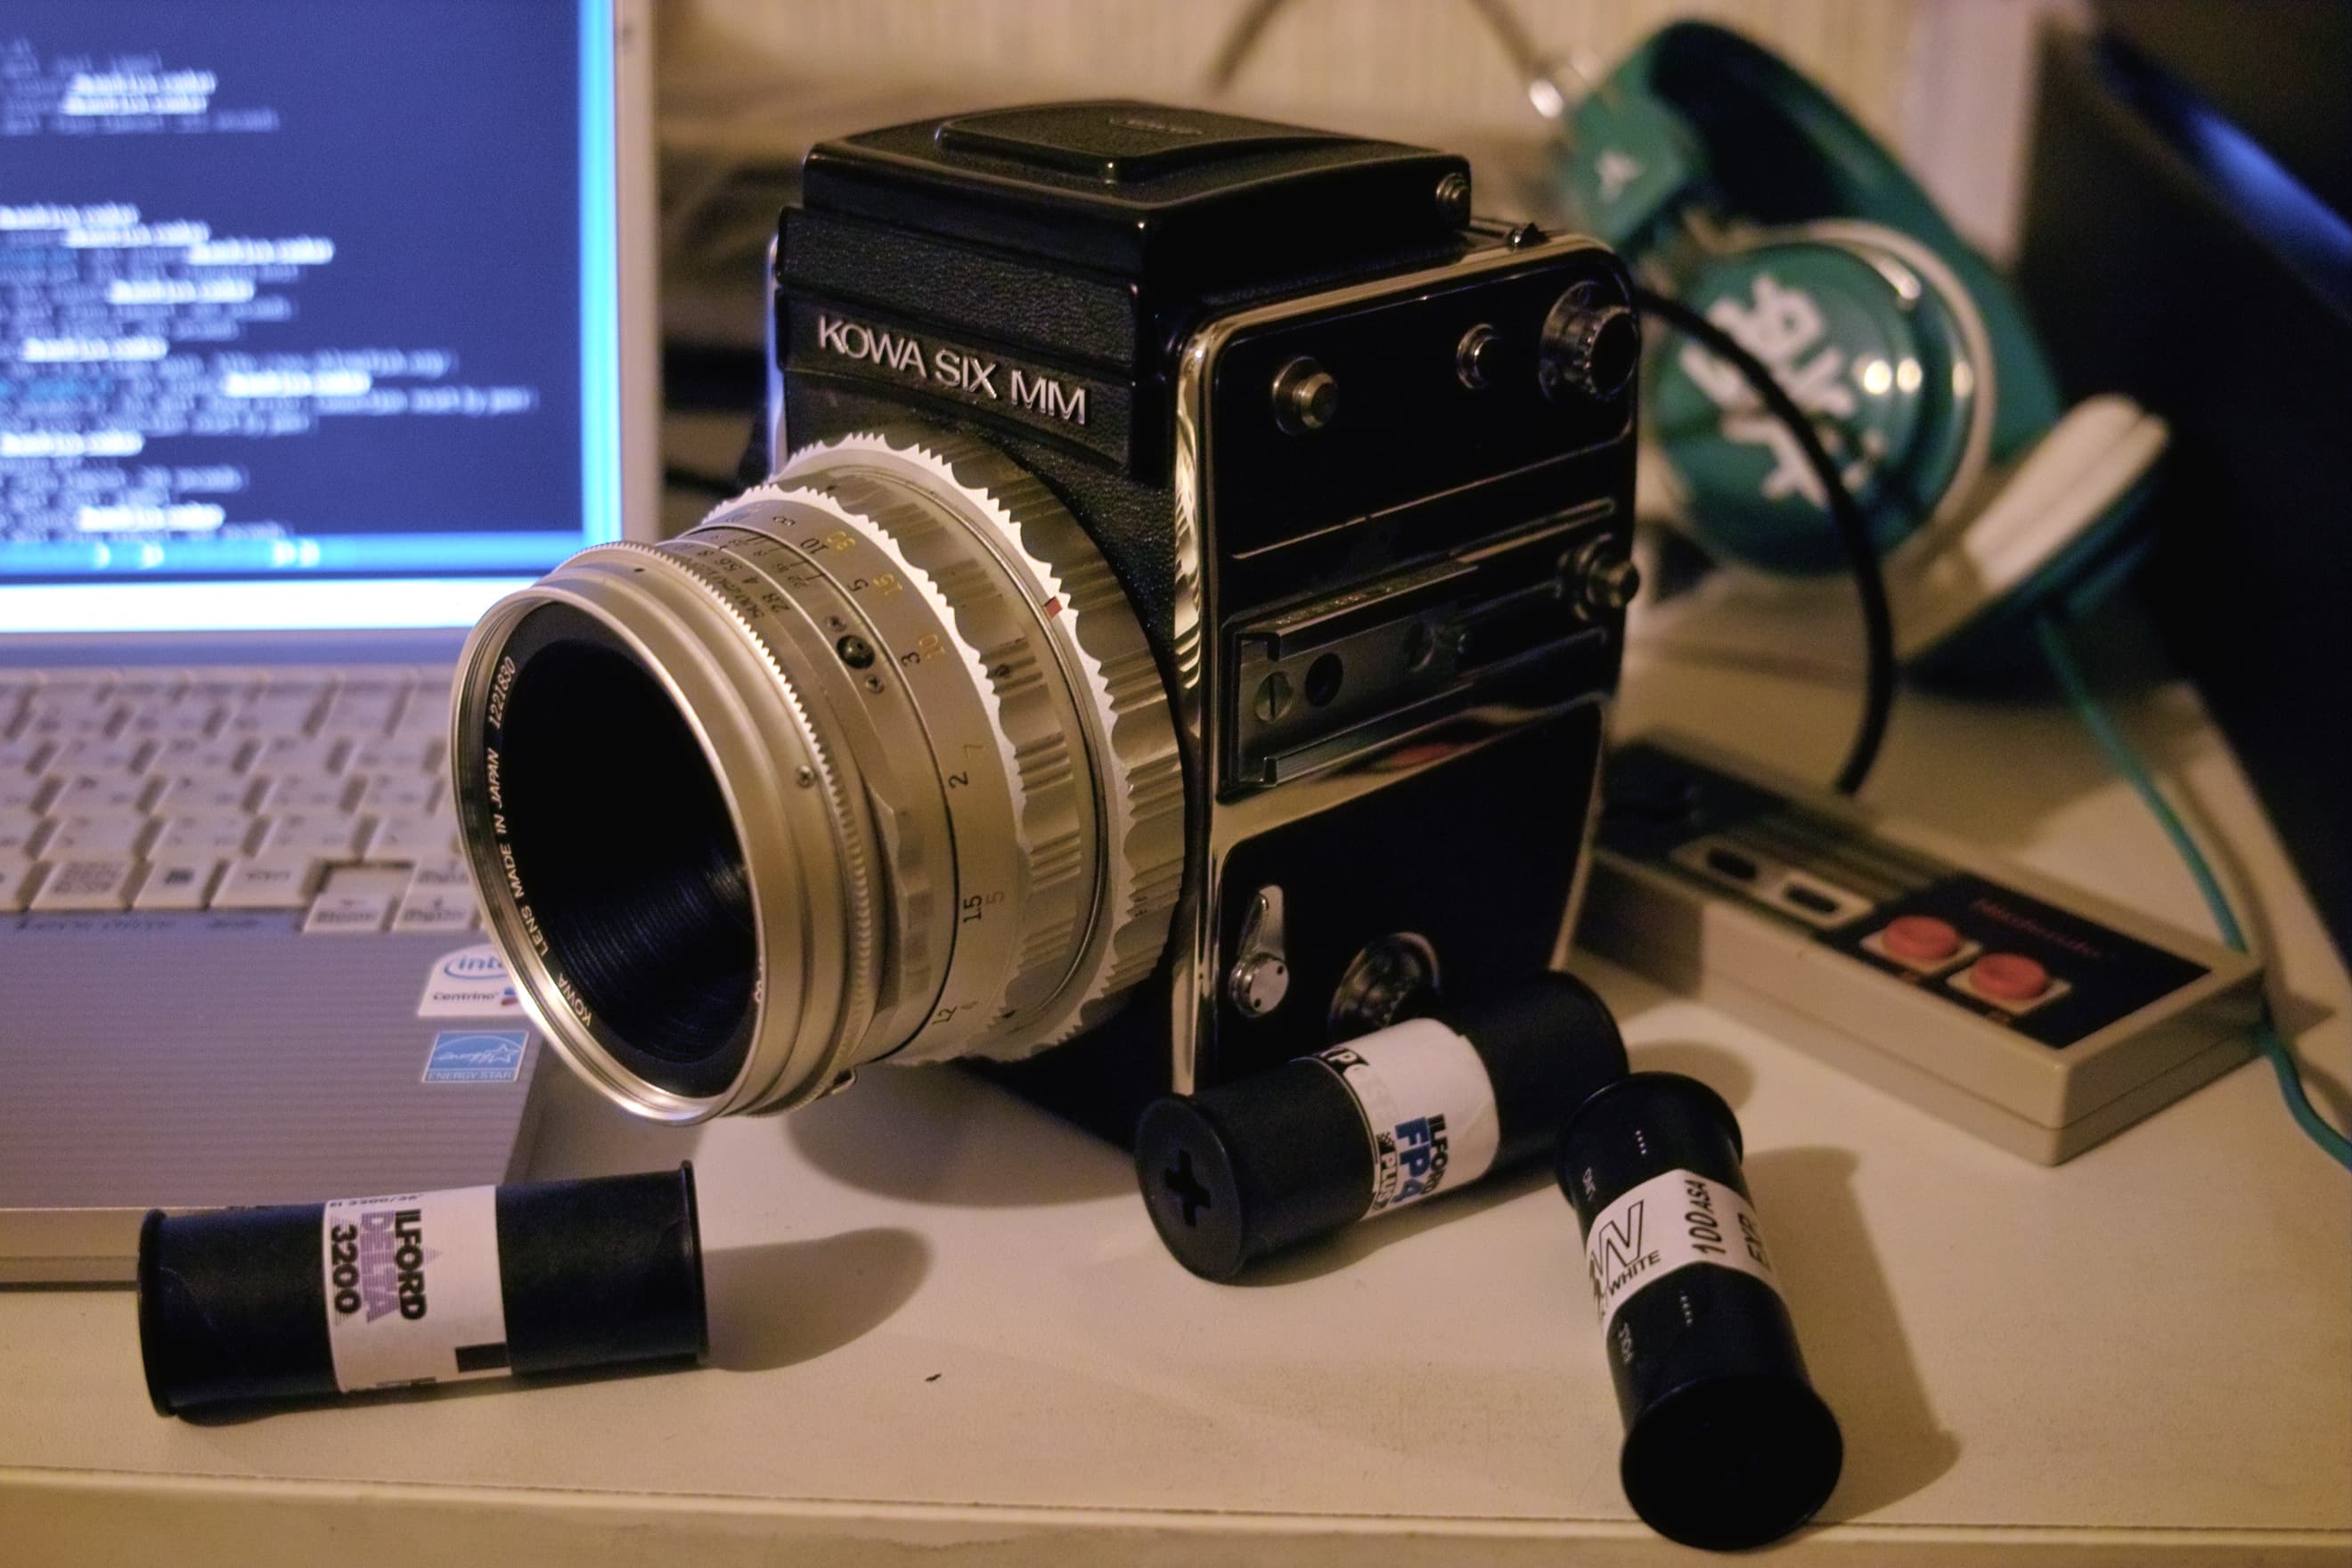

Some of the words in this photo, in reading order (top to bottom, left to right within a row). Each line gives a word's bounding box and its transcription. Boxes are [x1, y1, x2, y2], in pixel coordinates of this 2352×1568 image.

[818, 314, 927, 379] KOWA
[935, 348, 998, 399] SIX
[1011, 370, 1086, 425] MM
[489, 656, 517, 729] 1221830
[800, 537, 829, 555] 10
[847, 578, 869, 592] 5
[901, 651, 921, 666] 3
[948, 772, 969, 788] 2
[487, 747, 503, 810] JAPAN
[494, 813, 507, 834] IN
[500, 843, 525, 898] MADE
[521, 904, 549, 956] LENS
[558, 973, 592, 1026] KOWA
[1390, 1116, 1431, 1204] FP4
[331, 1223, 362, 1314] 3200
[360, 1210, 400, 1324] DELTA
[395, 1208, 428, 1320] ILFORD
[1608, 1249, 1662, 1297] WHITE
